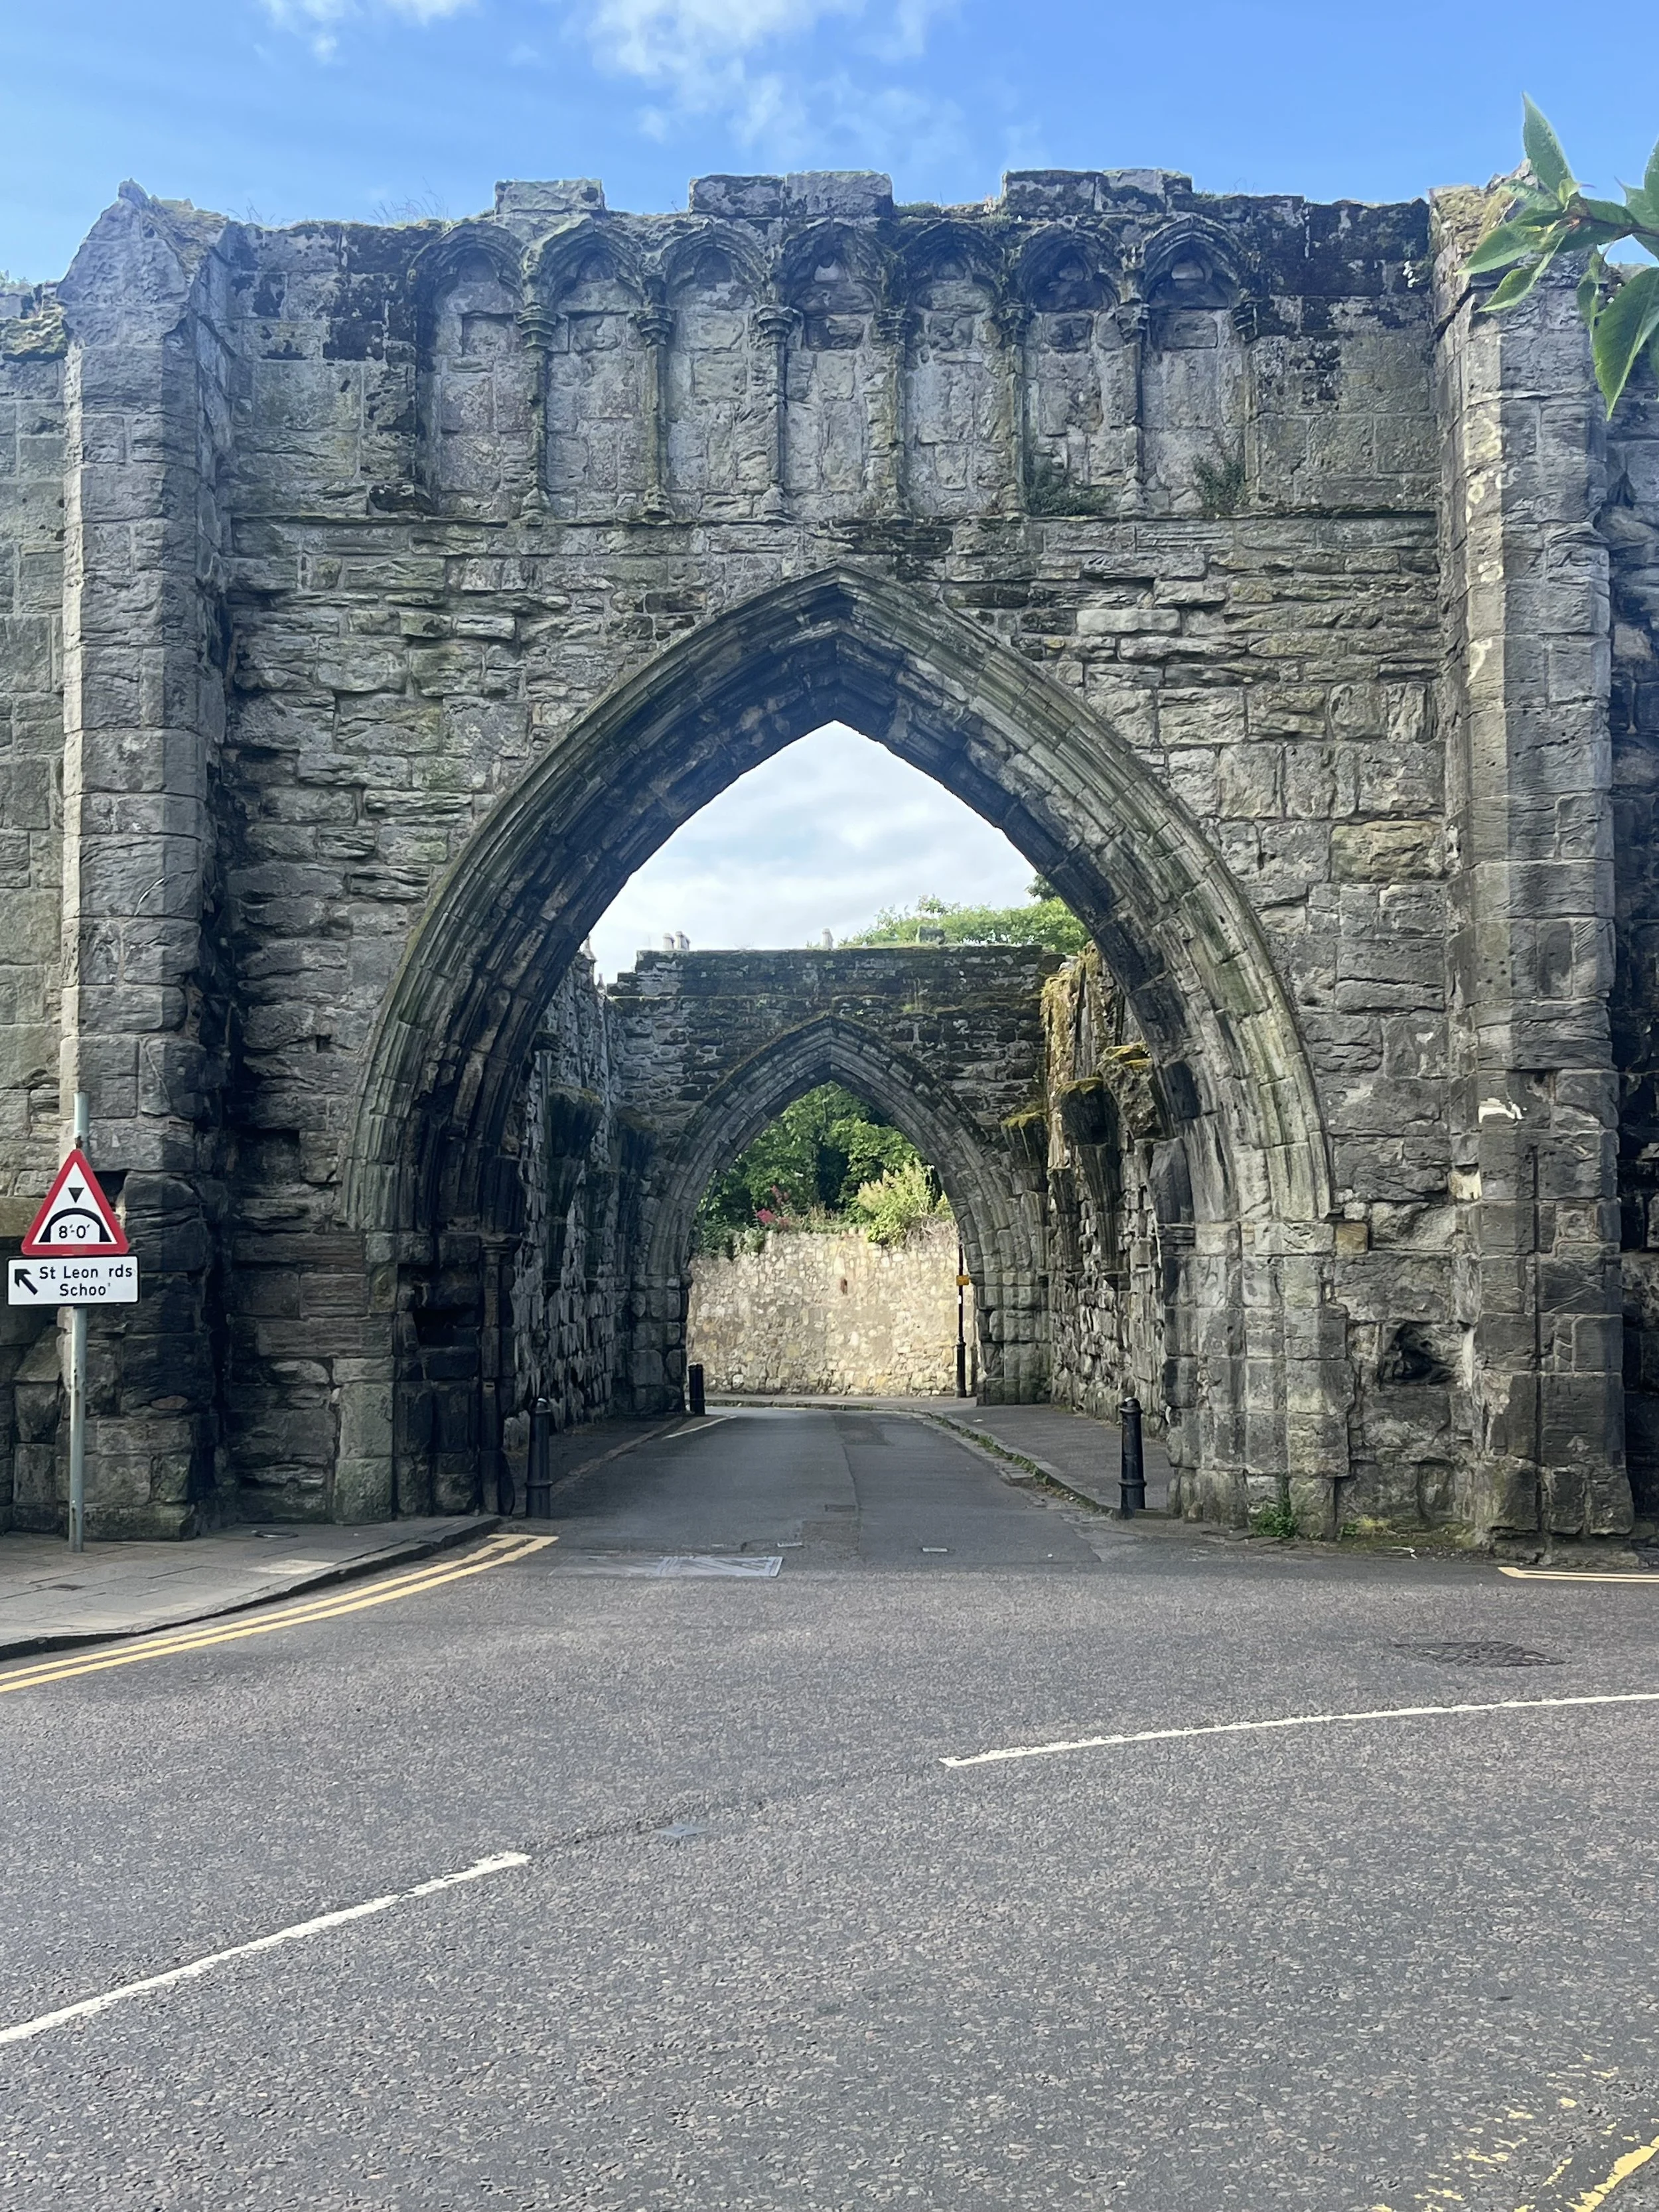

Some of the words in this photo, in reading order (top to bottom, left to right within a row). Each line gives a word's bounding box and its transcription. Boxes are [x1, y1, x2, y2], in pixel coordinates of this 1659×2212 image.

[38, 1266, 56, 1280] St
[63, 1264, 133, 1280] Leonrds
[59, 1282, 111, 1297] Schoo
